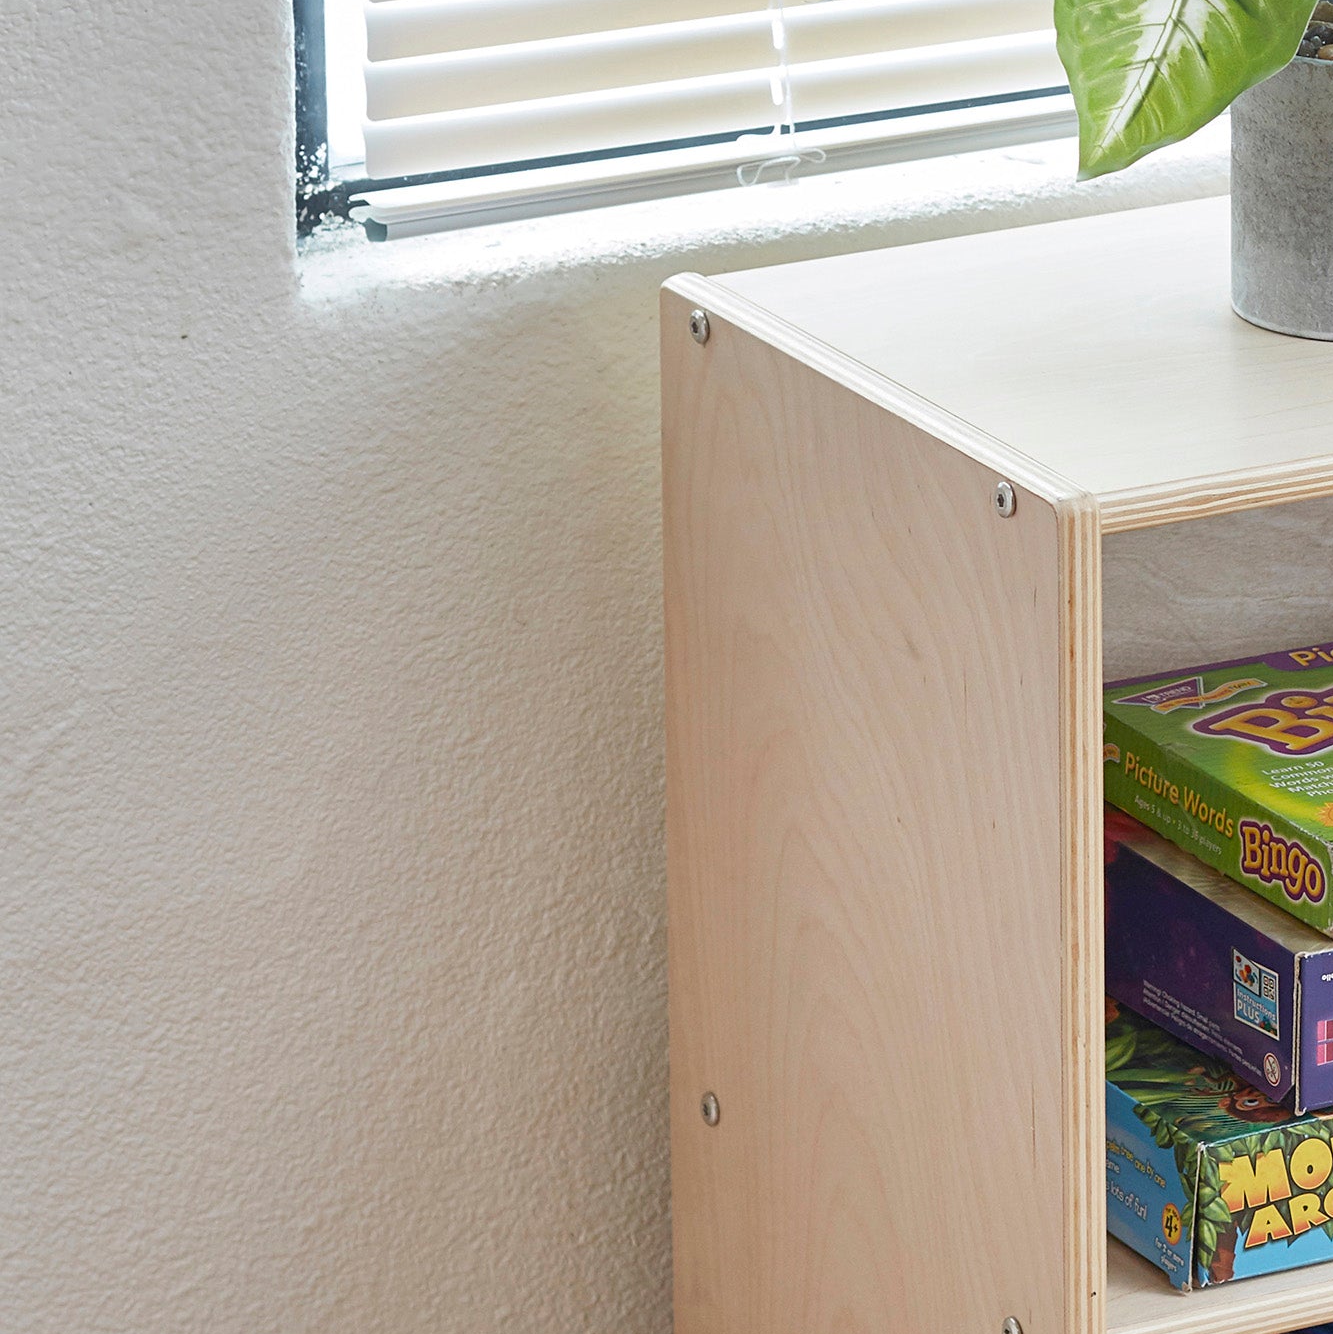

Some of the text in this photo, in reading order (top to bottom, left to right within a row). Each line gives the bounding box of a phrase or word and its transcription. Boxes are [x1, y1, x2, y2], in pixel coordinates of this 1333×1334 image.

[1262, 759, 1324, 775] Learn 50
[1270, 774, 1320, 789] Words
[1125, 751, 1234, 839] Picture Words
[1240, 824, 1323, 898] Bingo
[1236, 987, 1277, 1021] Instructions
[1237, 998, 1260, 1025] PLUS
